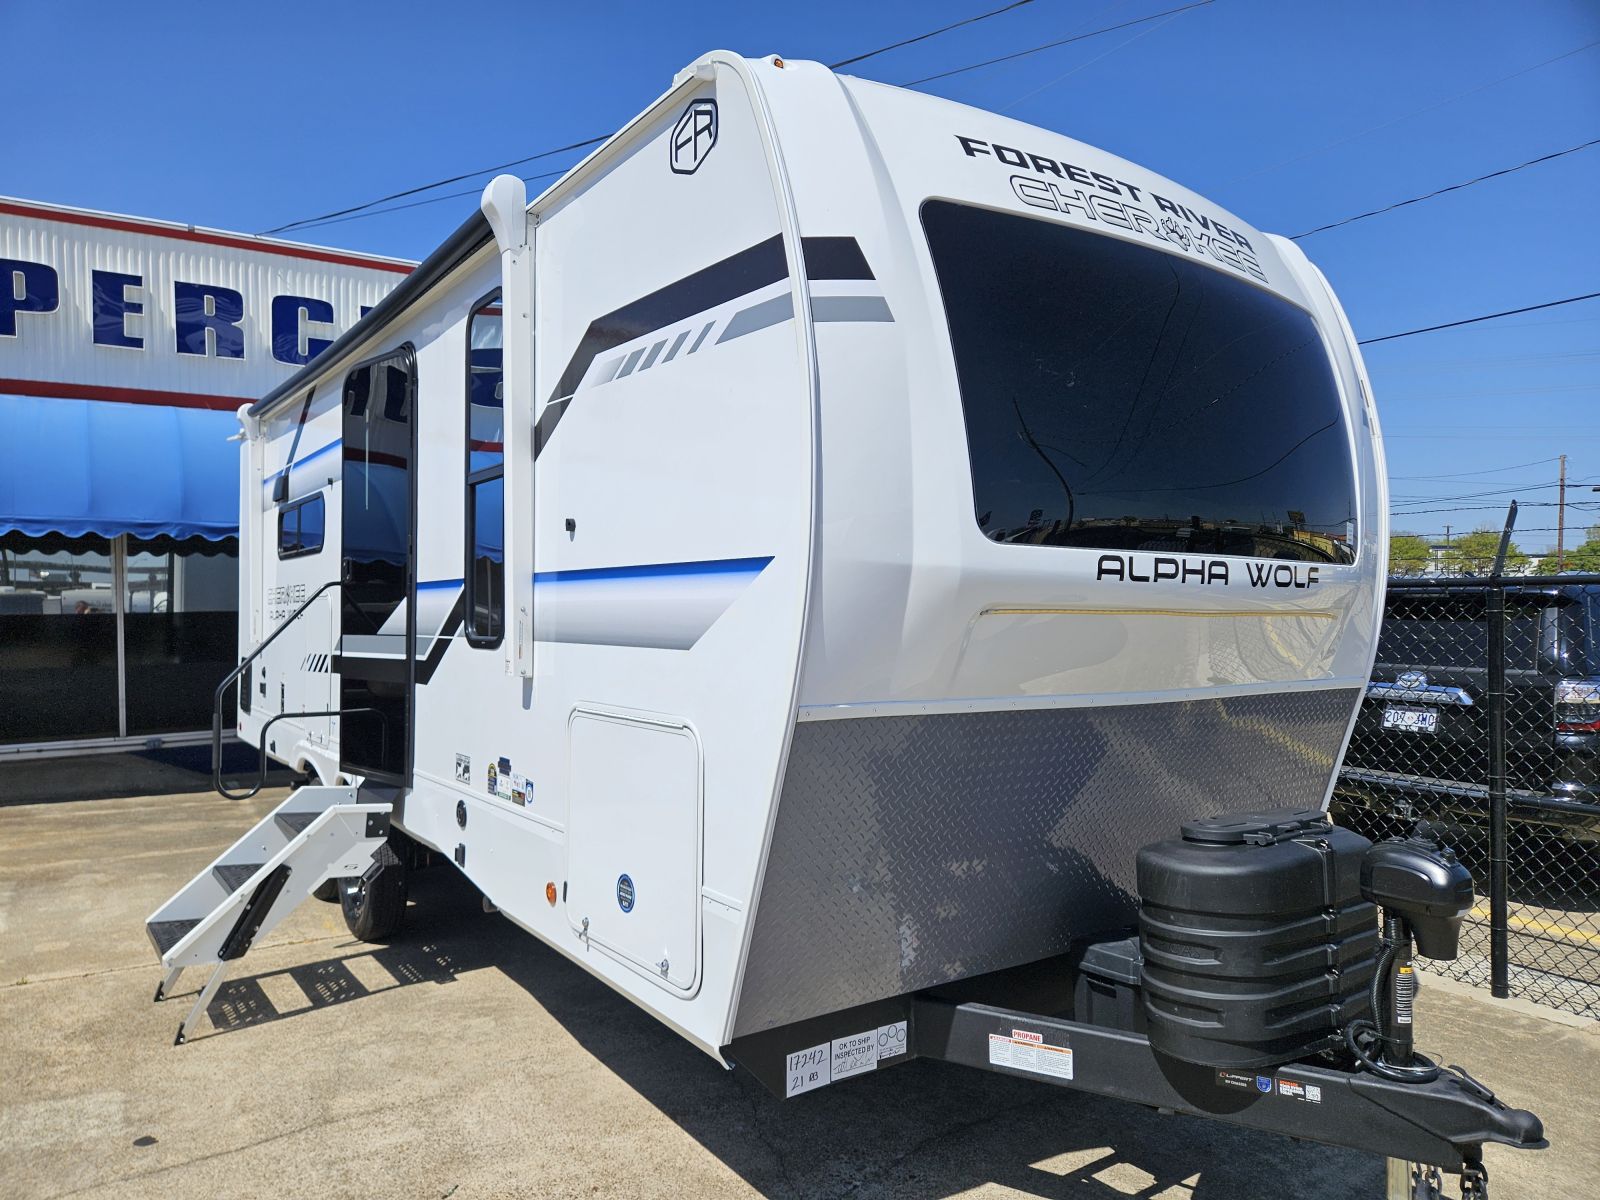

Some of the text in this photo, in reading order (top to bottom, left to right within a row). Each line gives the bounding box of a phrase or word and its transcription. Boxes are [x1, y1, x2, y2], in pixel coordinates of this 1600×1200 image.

[954, 134, 1256, 255] FOREST RIVER
[0, 257, 376, 366] PERC
[1096, 554, 1320, 589] ALPHA WOLF
[839, 1036, 871, 1051] OK TO SHIP
[1013, 1030, 1041, 1042] PROPANE
[789, 1049, 828, 1071] 17242
[835, 1045, 866, 1060] INSPECTED
[867, 1043, 874, 1052] BY
